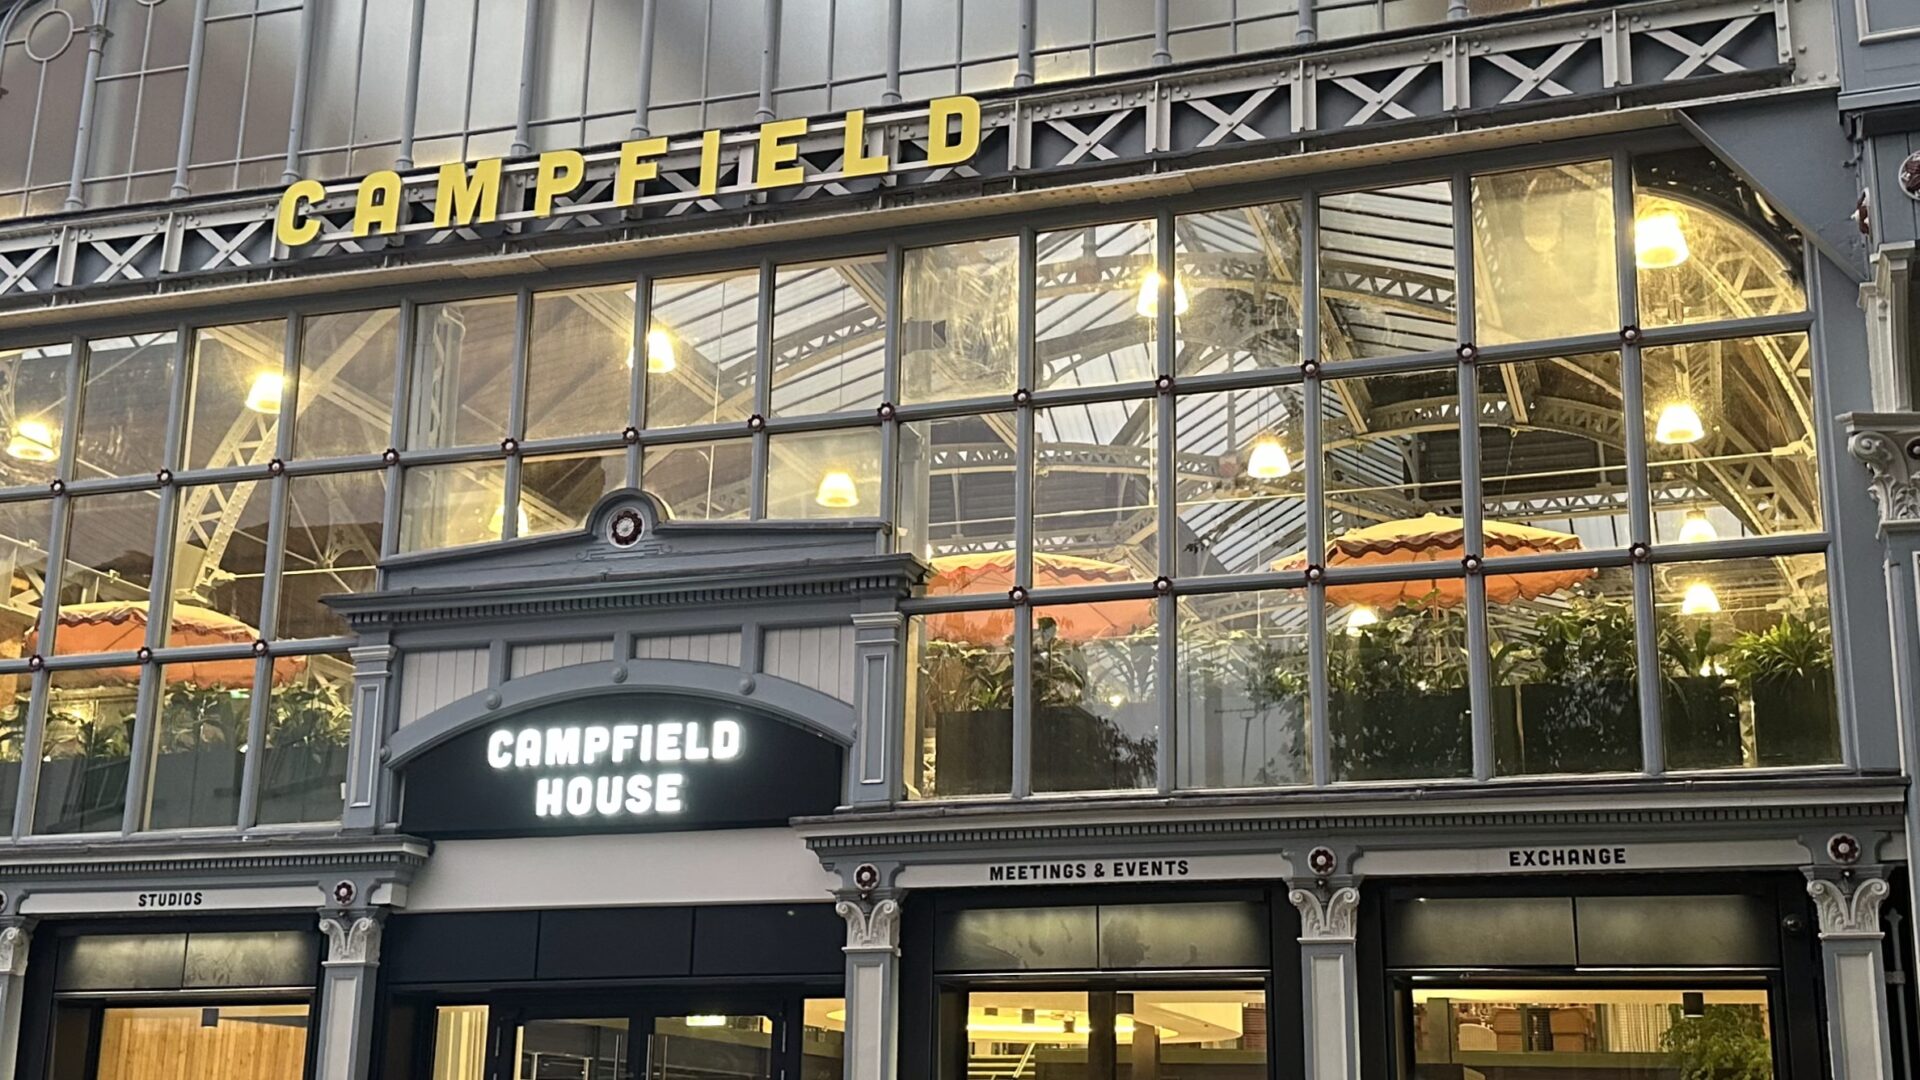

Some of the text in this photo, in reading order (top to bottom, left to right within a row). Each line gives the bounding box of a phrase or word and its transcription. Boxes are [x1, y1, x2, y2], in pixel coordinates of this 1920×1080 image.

[277, 95, 982, 246] CAMPFIELD
[487, 719, 742, 769] CAMPFIELD
[535, 773, 684, 817] HOUSE
[990, 860, 1189, 880] MEETINGS & EVENTS
[1509, 848, 1627, 867] EXCHANGE
[138, 891, 203, 907] STUDIOS
